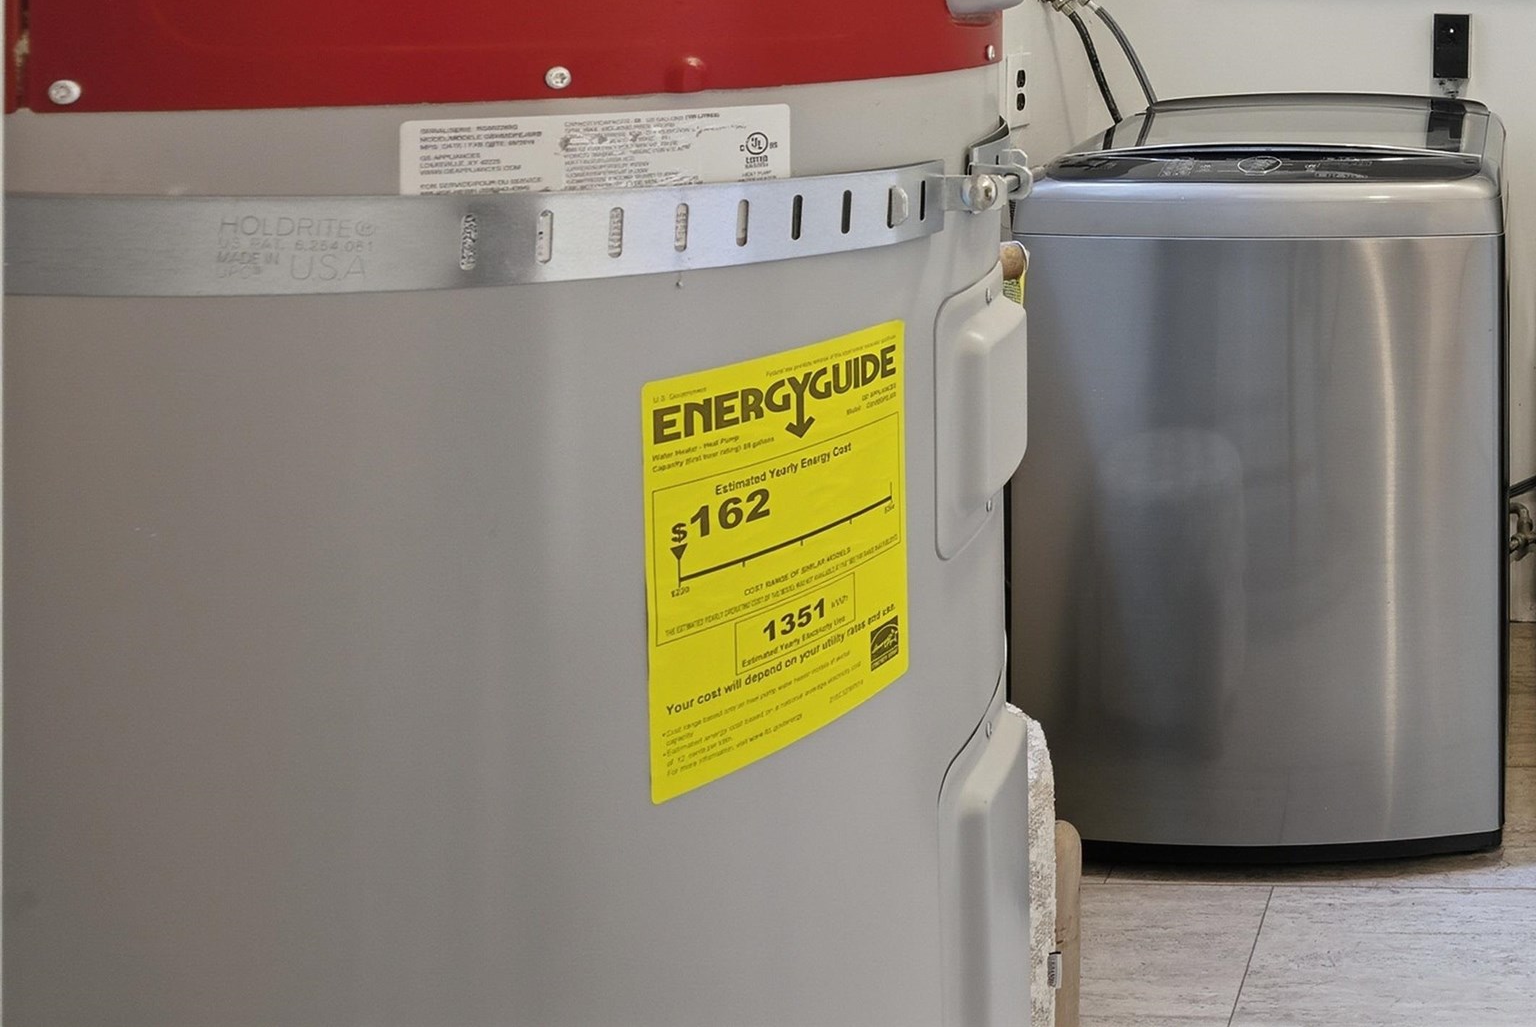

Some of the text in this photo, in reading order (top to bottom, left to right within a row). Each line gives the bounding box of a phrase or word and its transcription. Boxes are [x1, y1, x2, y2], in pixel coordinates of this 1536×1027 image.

[652, 460, 684, 473] Capacity
[752, 436, 775, 448] gallons
[720, 434, 740, 446] Pump
[715, 441, 852, 496] Estimated Yearly Energy Cost
[671, 487, 770, 544] $162
[763, 598, 826, 642] 1351
[666, 698, 694, 715] Your
[697, 688, 722, 704] cost
[724, 678, 742, 694] will
[745, 662, 782, 687] depend
[785, 655, 797, 668] on
[799, 644, 821, 664] your
[822, 631, 846, 651] utility
[847, 621, 866, 636] rates
[742, 648, 778, 668] Estimated
[780, 638, 801, 651] Yearly
